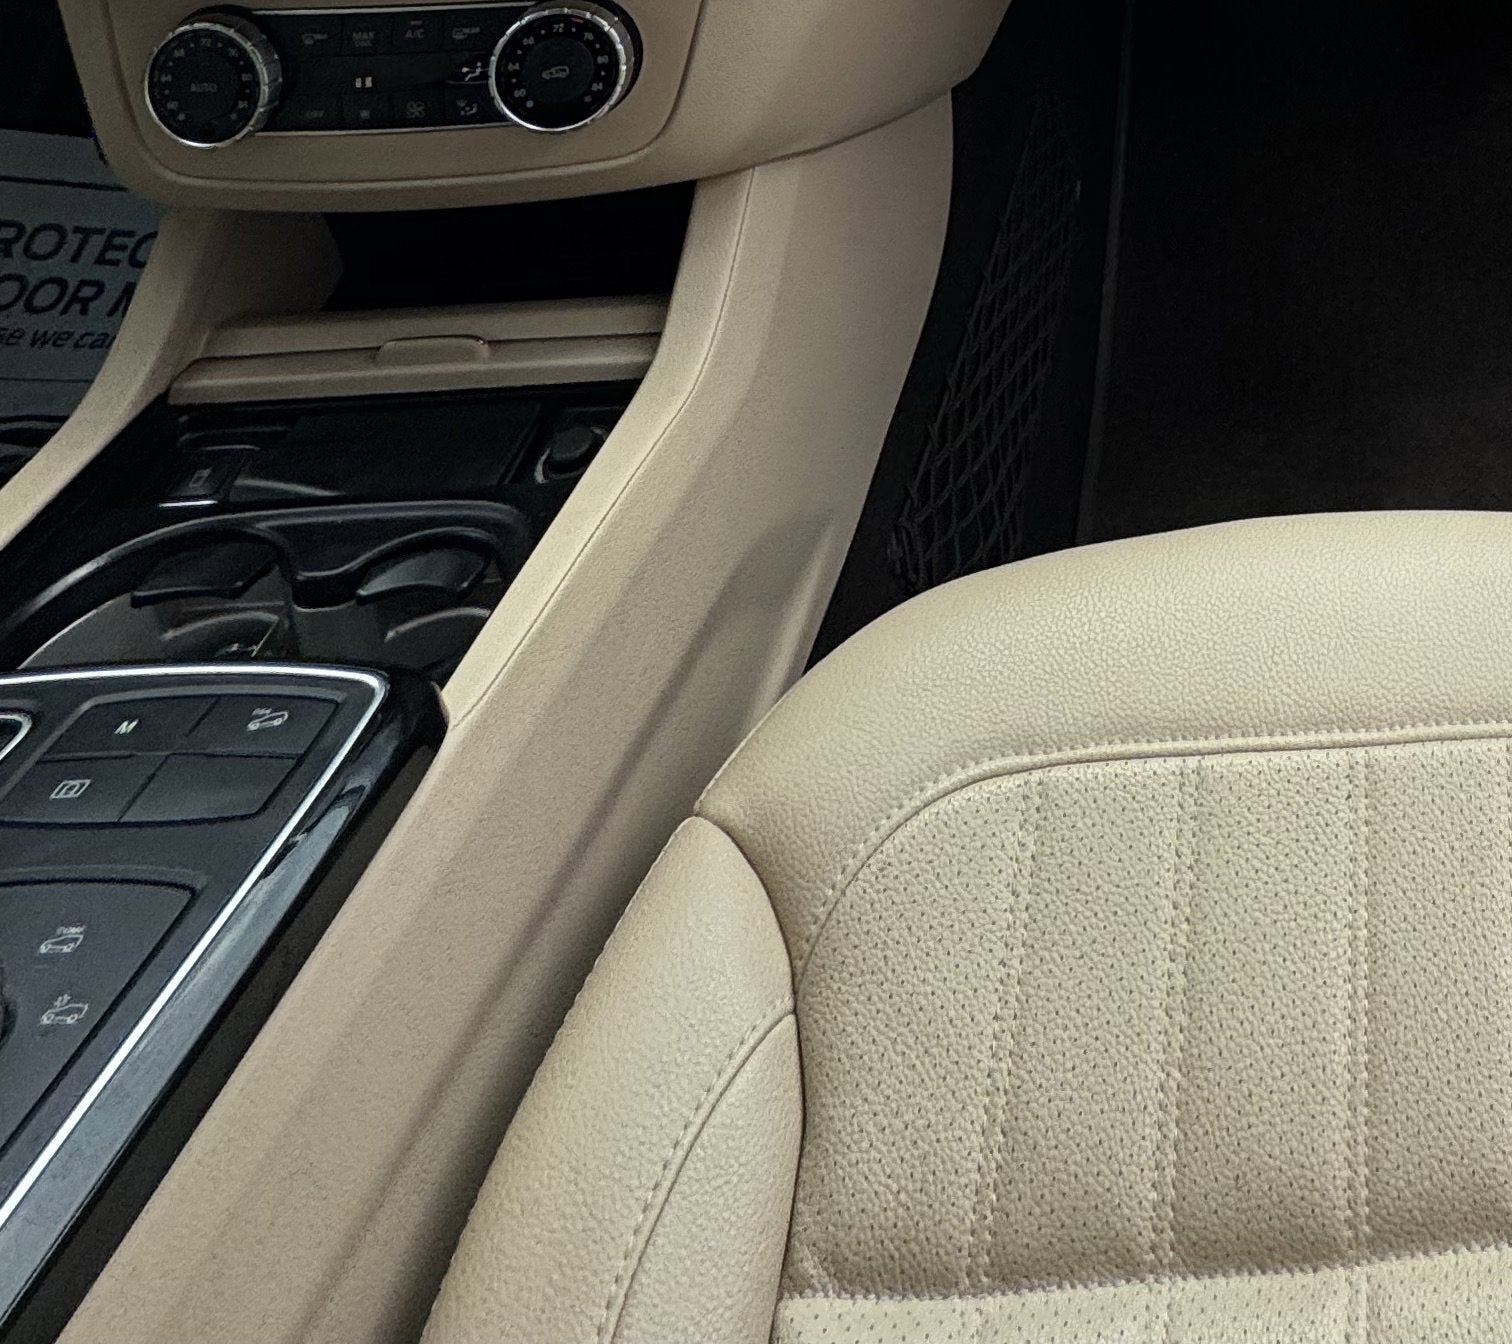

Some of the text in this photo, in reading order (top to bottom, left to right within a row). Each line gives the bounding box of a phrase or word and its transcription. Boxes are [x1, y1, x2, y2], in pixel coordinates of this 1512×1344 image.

[553, 23, 565, 33] 72
[404, 29, 425, 39] A/C
[507, 62, 520, 71] 64
[513, 88, 527, 98] 60
[29, 329, 73, 349] we
[114, 718, 140, 735] M
